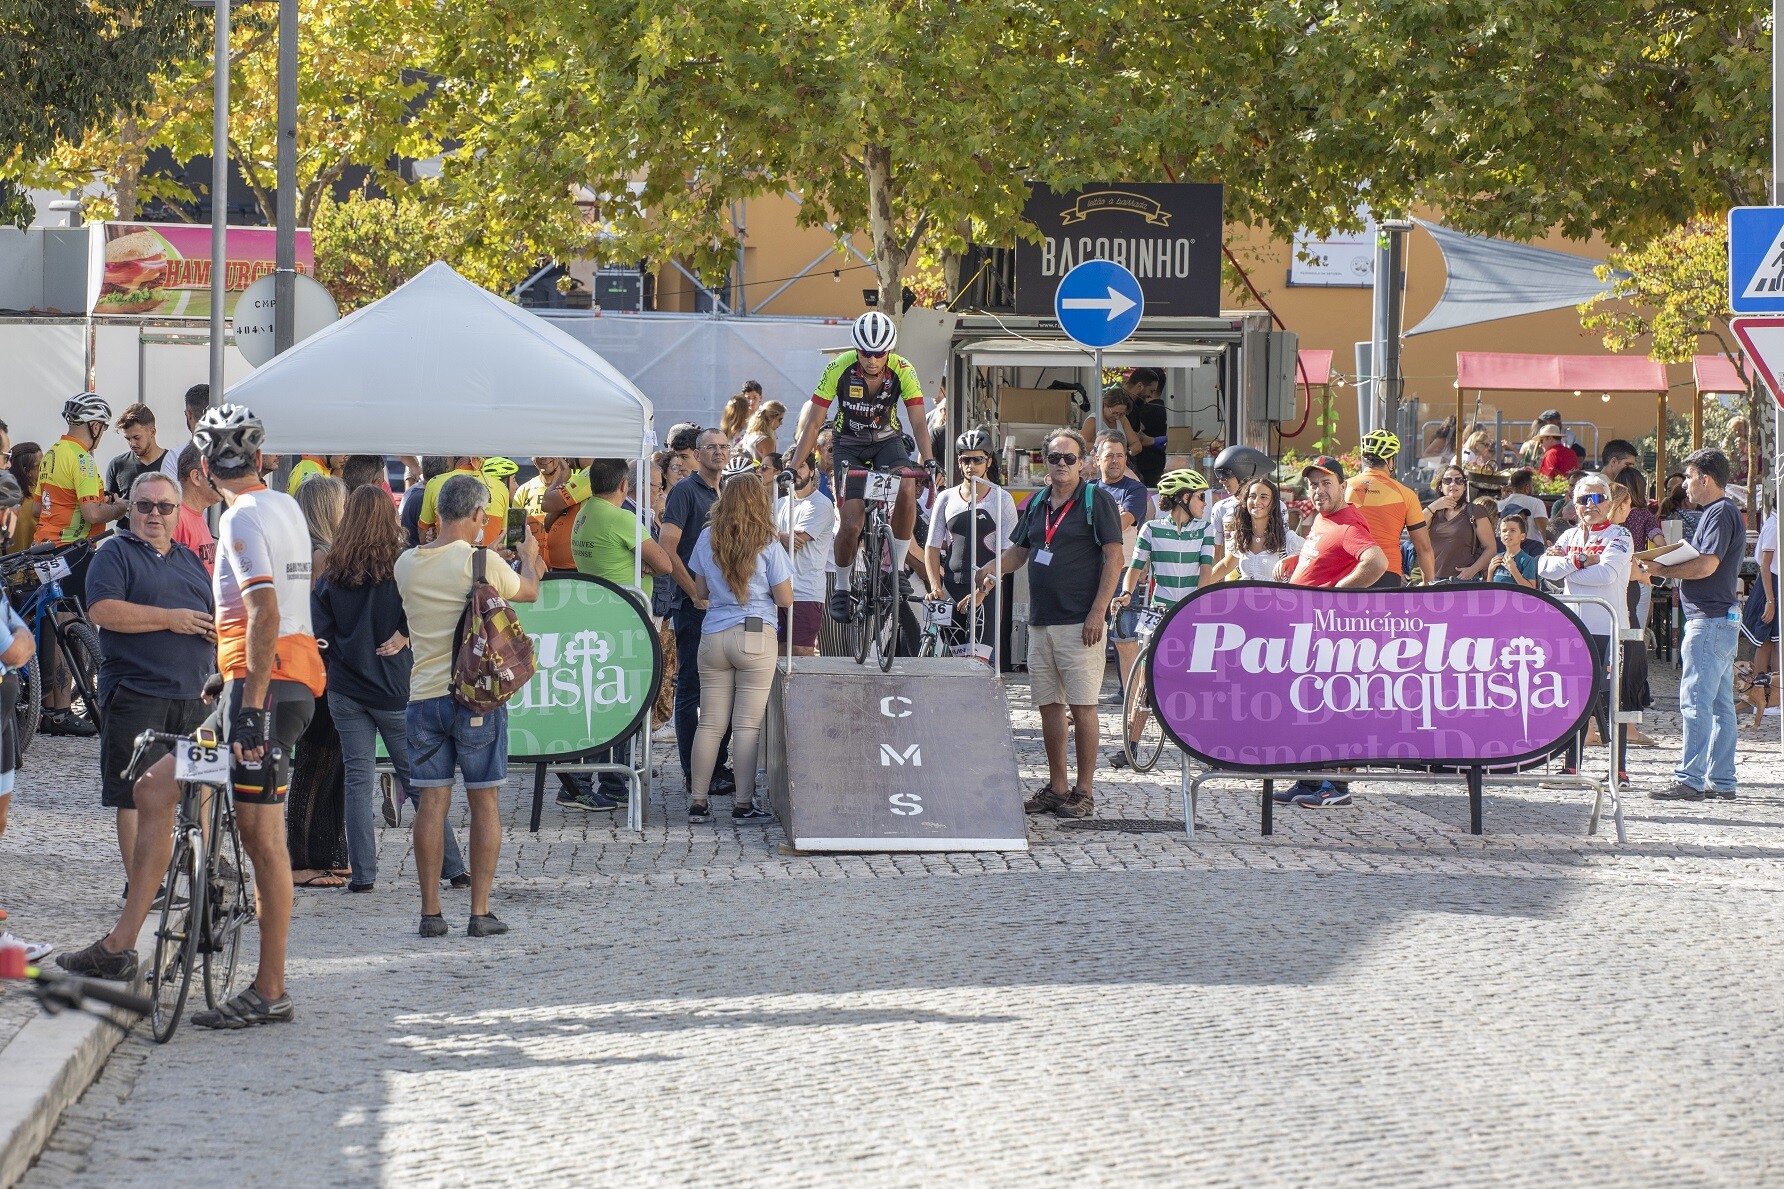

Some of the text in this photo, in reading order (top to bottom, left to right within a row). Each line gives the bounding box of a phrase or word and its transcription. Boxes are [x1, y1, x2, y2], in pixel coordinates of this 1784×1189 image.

[163, 259, 306, 292] HAMURG
[928, 603, 946, 614] 36
[1313, 609, 1424, 638] Município
[1186, 622, 1498, 674] Palmela
[1289, 668, 1570, 738] conquista
[187, 745, 219, 763] 65
